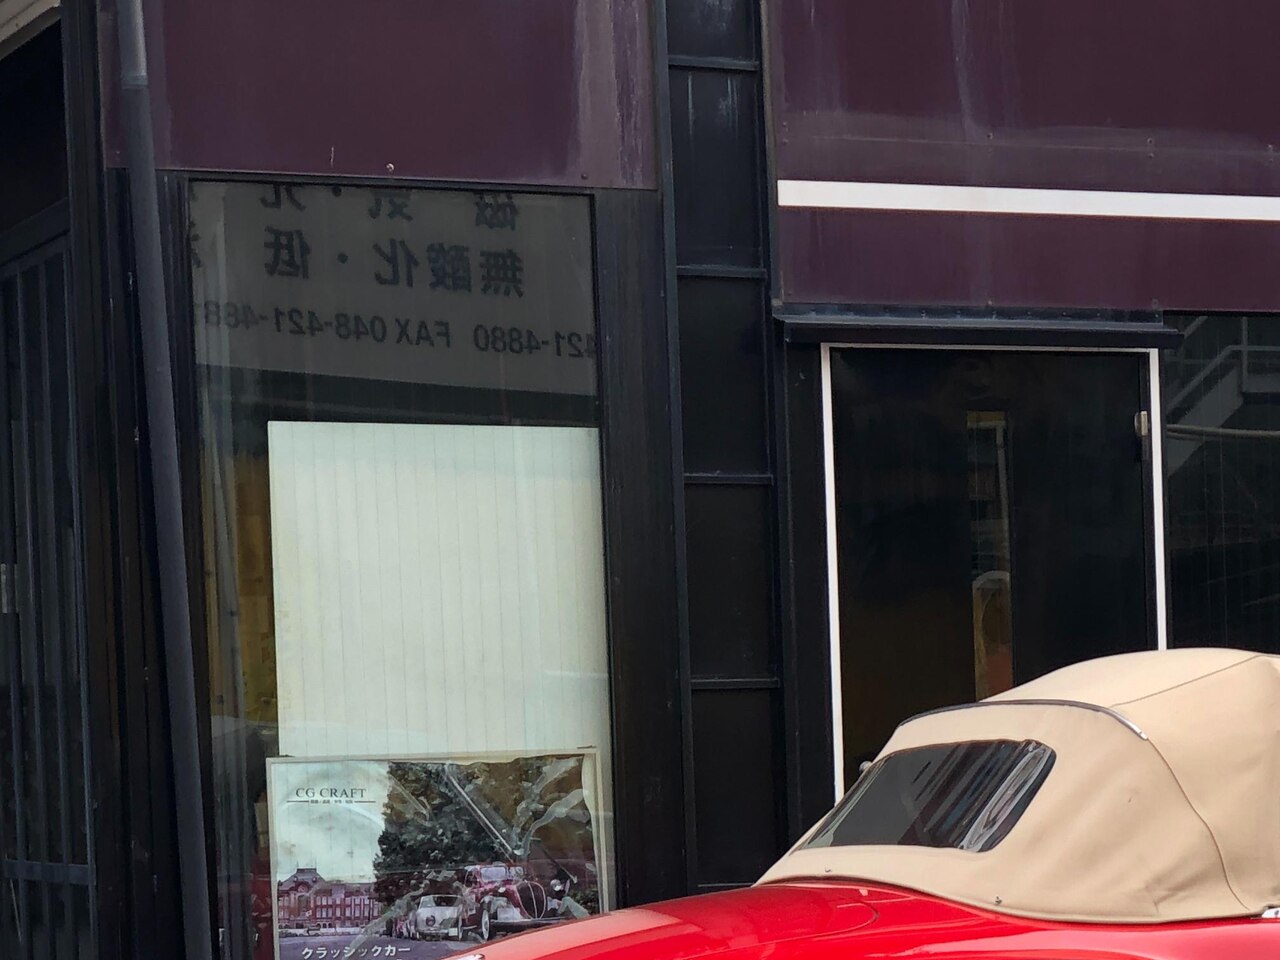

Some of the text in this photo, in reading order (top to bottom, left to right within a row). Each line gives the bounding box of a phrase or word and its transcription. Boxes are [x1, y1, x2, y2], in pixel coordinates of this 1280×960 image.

[295, 787, 367, 799] CG CRAFT
[301, 944, 411, 960] クラッシックカー
